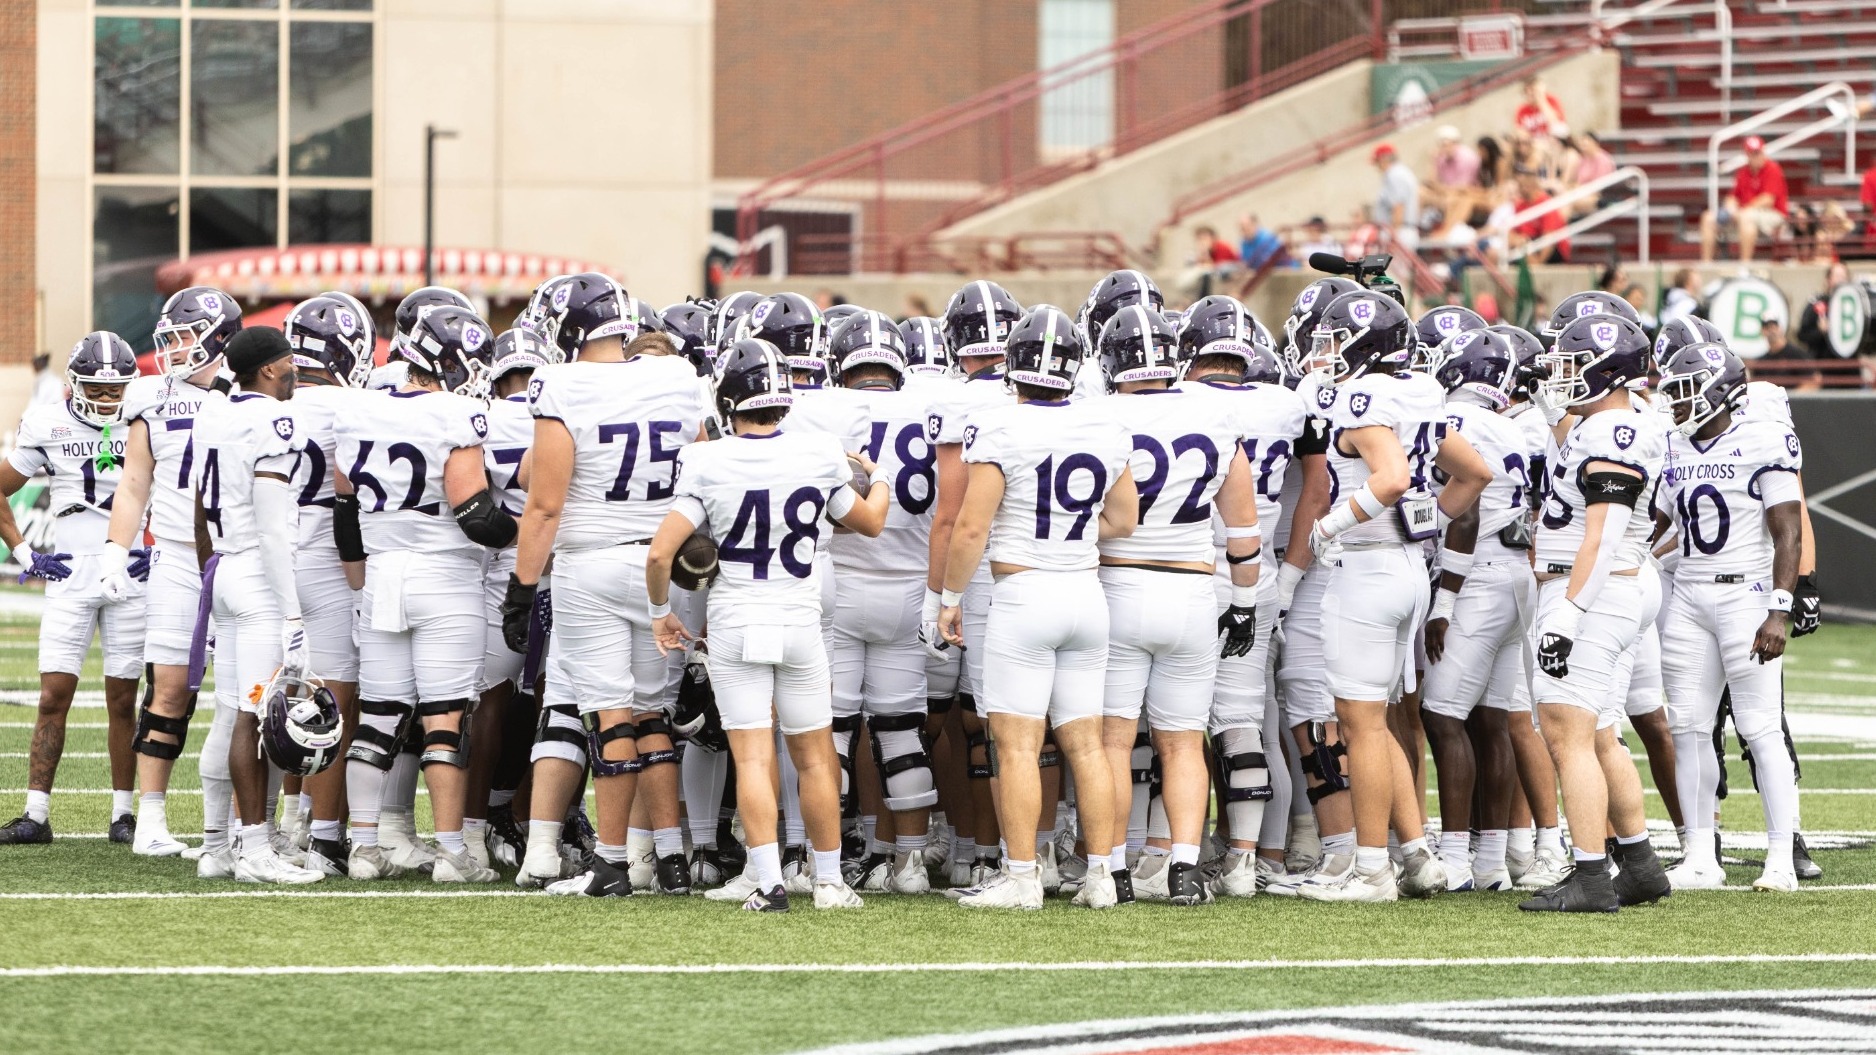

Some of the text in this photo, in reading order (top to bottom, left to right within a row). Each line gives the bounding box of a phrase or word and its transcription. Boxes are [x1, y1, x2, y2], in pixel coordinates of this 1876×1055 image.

[1733, 290, 1769, 340] B
[1840, 295, 1857, 341] B
[850, 351, 899, 364] CRUSADERS
[966, 345, 1002, 355] CRUSAD
[1212, 344, 1255, 358] CRUSADERS
[498, 355, 546, 368] CRUSADERS
[1016, 374, 1066, 388] CRUSADERS
[1123, 370, 1172, 381] CRUSADERS
[169, 401, 202, 416] HOLY
[749, 396, 794, 408] CRUSADERS
[62, 442, 94, 457] HOLY
[598, 421, 682, 501] 75
[349, 440, 440, 515] 62
[1131, 433, 1219, 526] 92
[1672, 463, 1735, 482] OLY CROSS
[1035, 452, 1108, 541] 19
[1676, 483, 1731, 558] 10
[717, 486, 826, 580] 48
